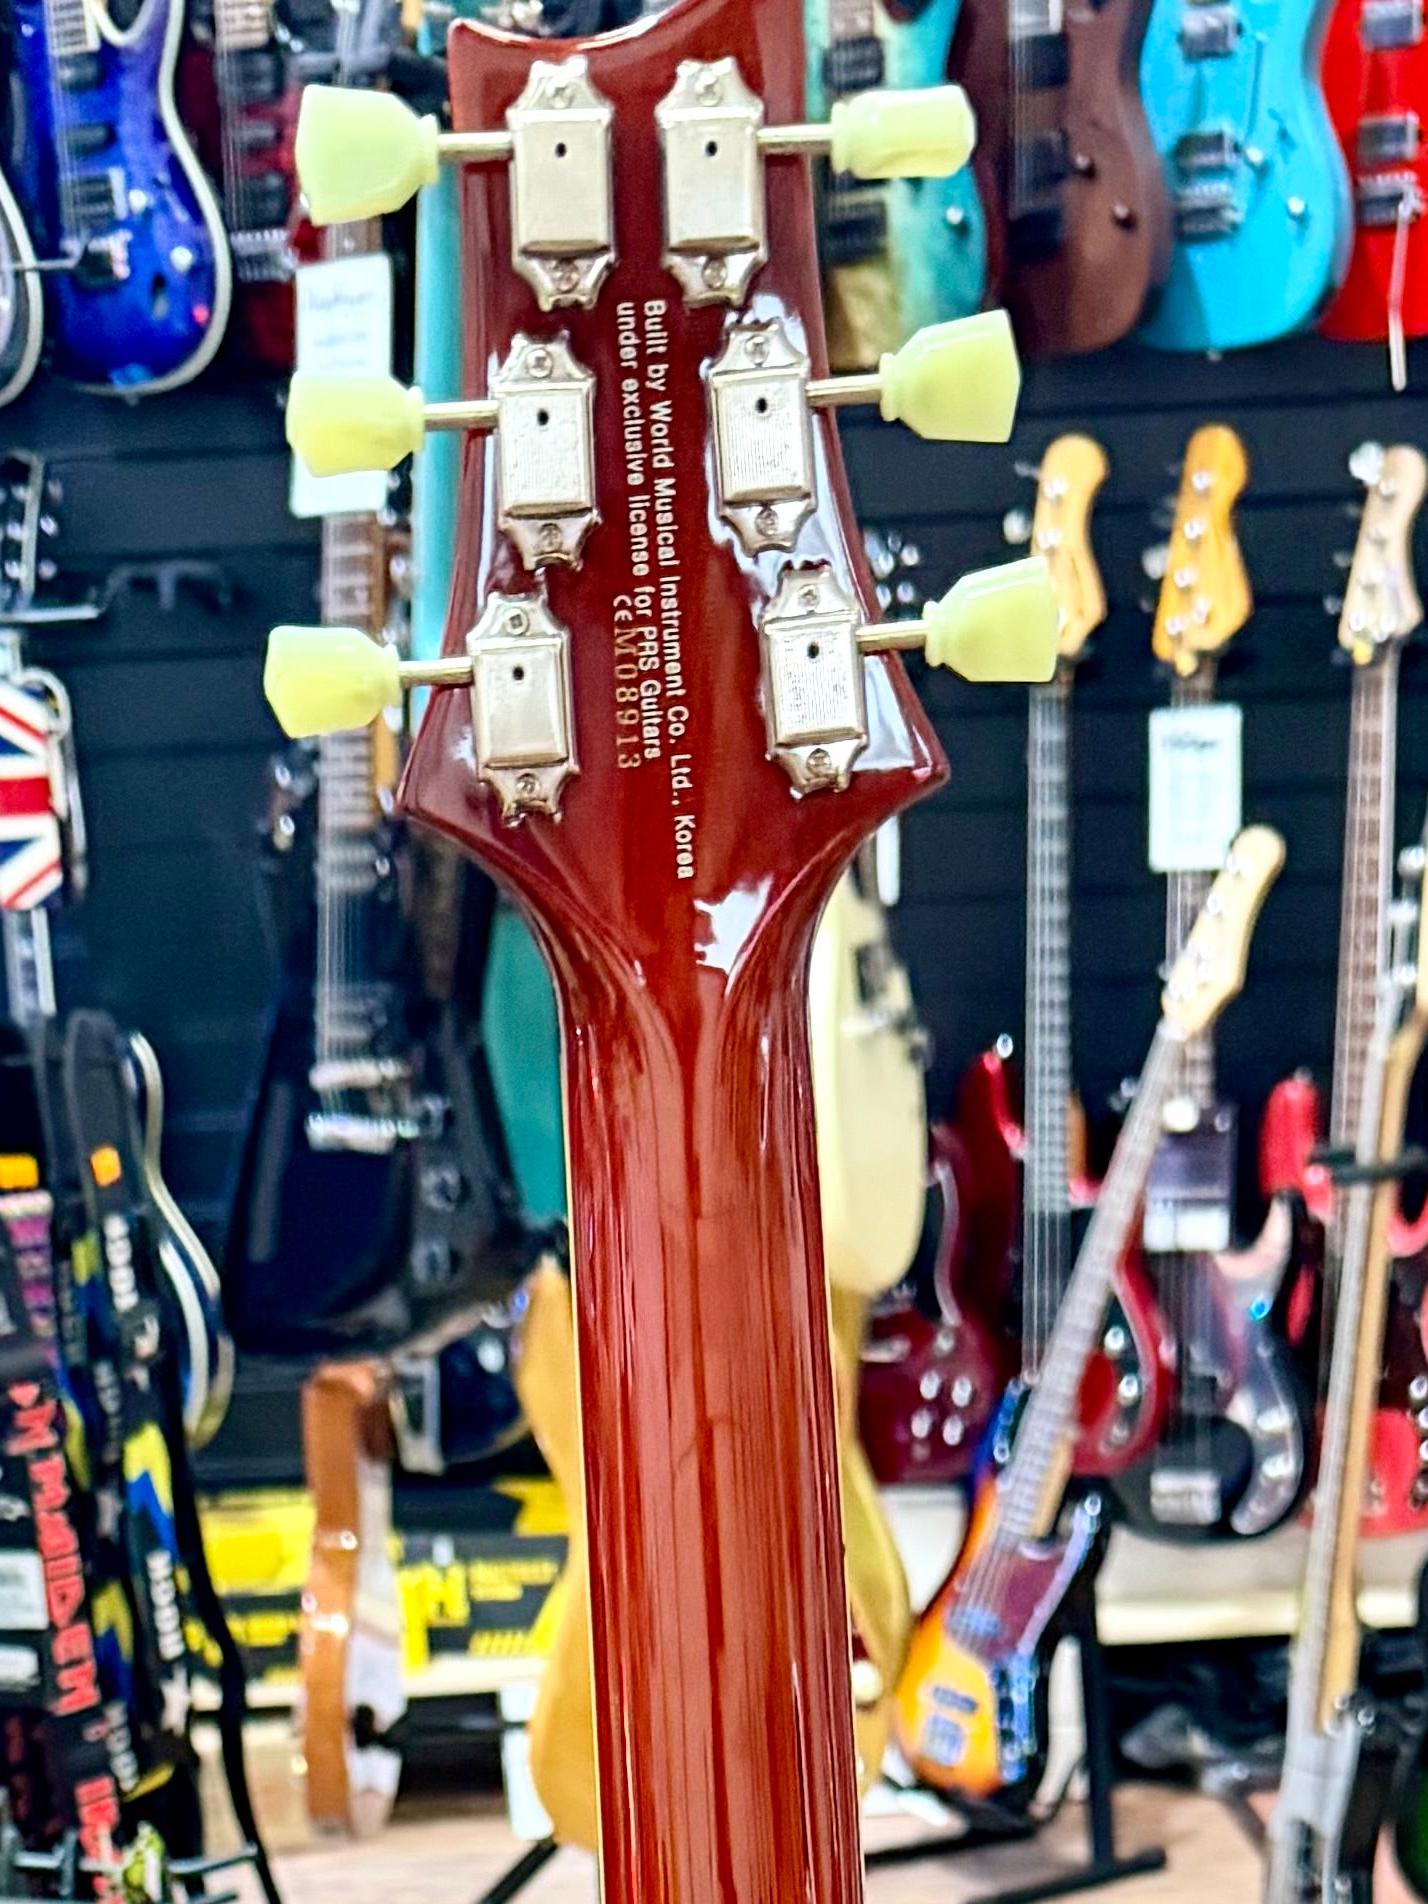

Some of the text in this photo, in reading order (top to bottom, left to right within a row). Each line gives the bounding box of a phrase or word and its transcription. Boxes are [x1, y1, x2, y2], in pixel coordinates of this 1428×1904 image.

[643, 300, 669, 355] Built
[645, 363, 669, 391] by
[649, 400, 675, 469] World
[616, 302, 663, 759] under exclusive license for PRS Guitars
[654, 478, 680, 567] Musical
[659, 576, 686, 697] Instrument
[667, 705, 689, 744] Co.
[674, 815, 695, 879] Korea
